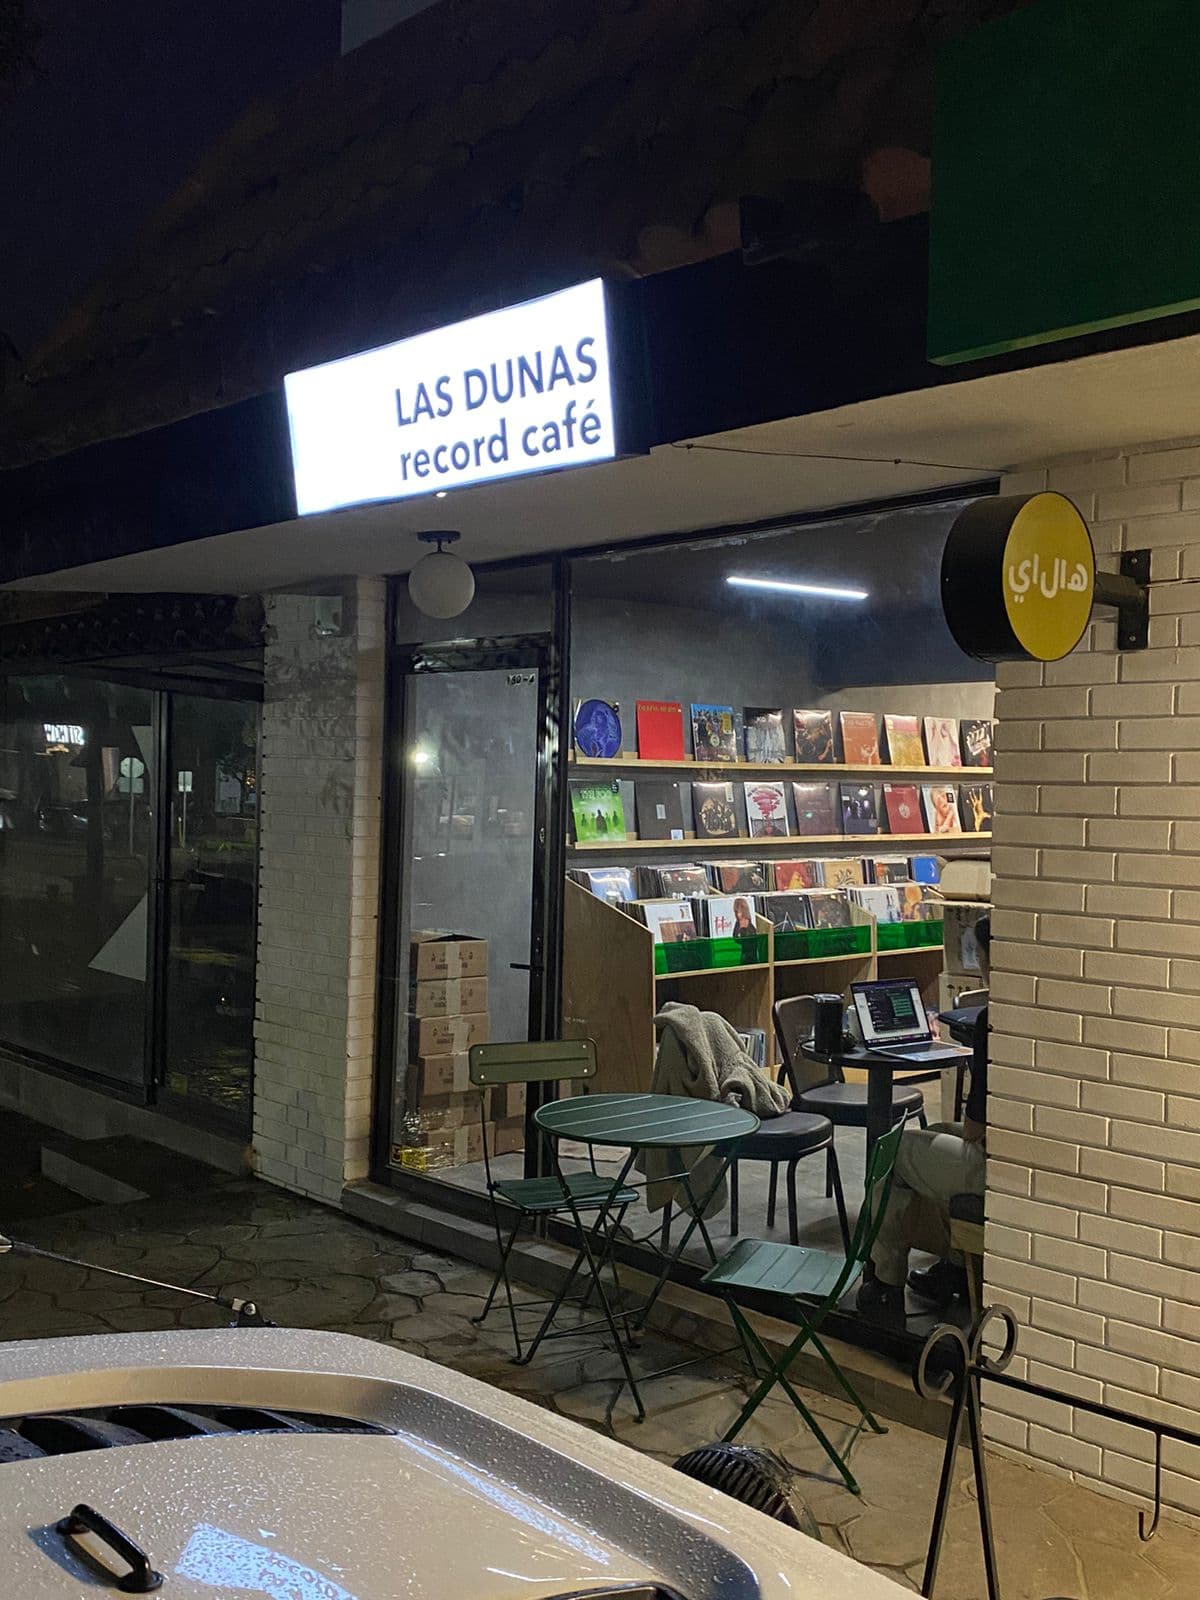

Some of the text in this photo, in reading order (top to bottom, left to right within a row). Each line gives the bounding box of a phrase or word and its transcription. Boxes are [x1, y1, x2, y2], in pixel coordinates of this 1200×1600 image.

[395, 336, 598, 427] LAS DUNAS
[400, 399, 601, 481] record café
